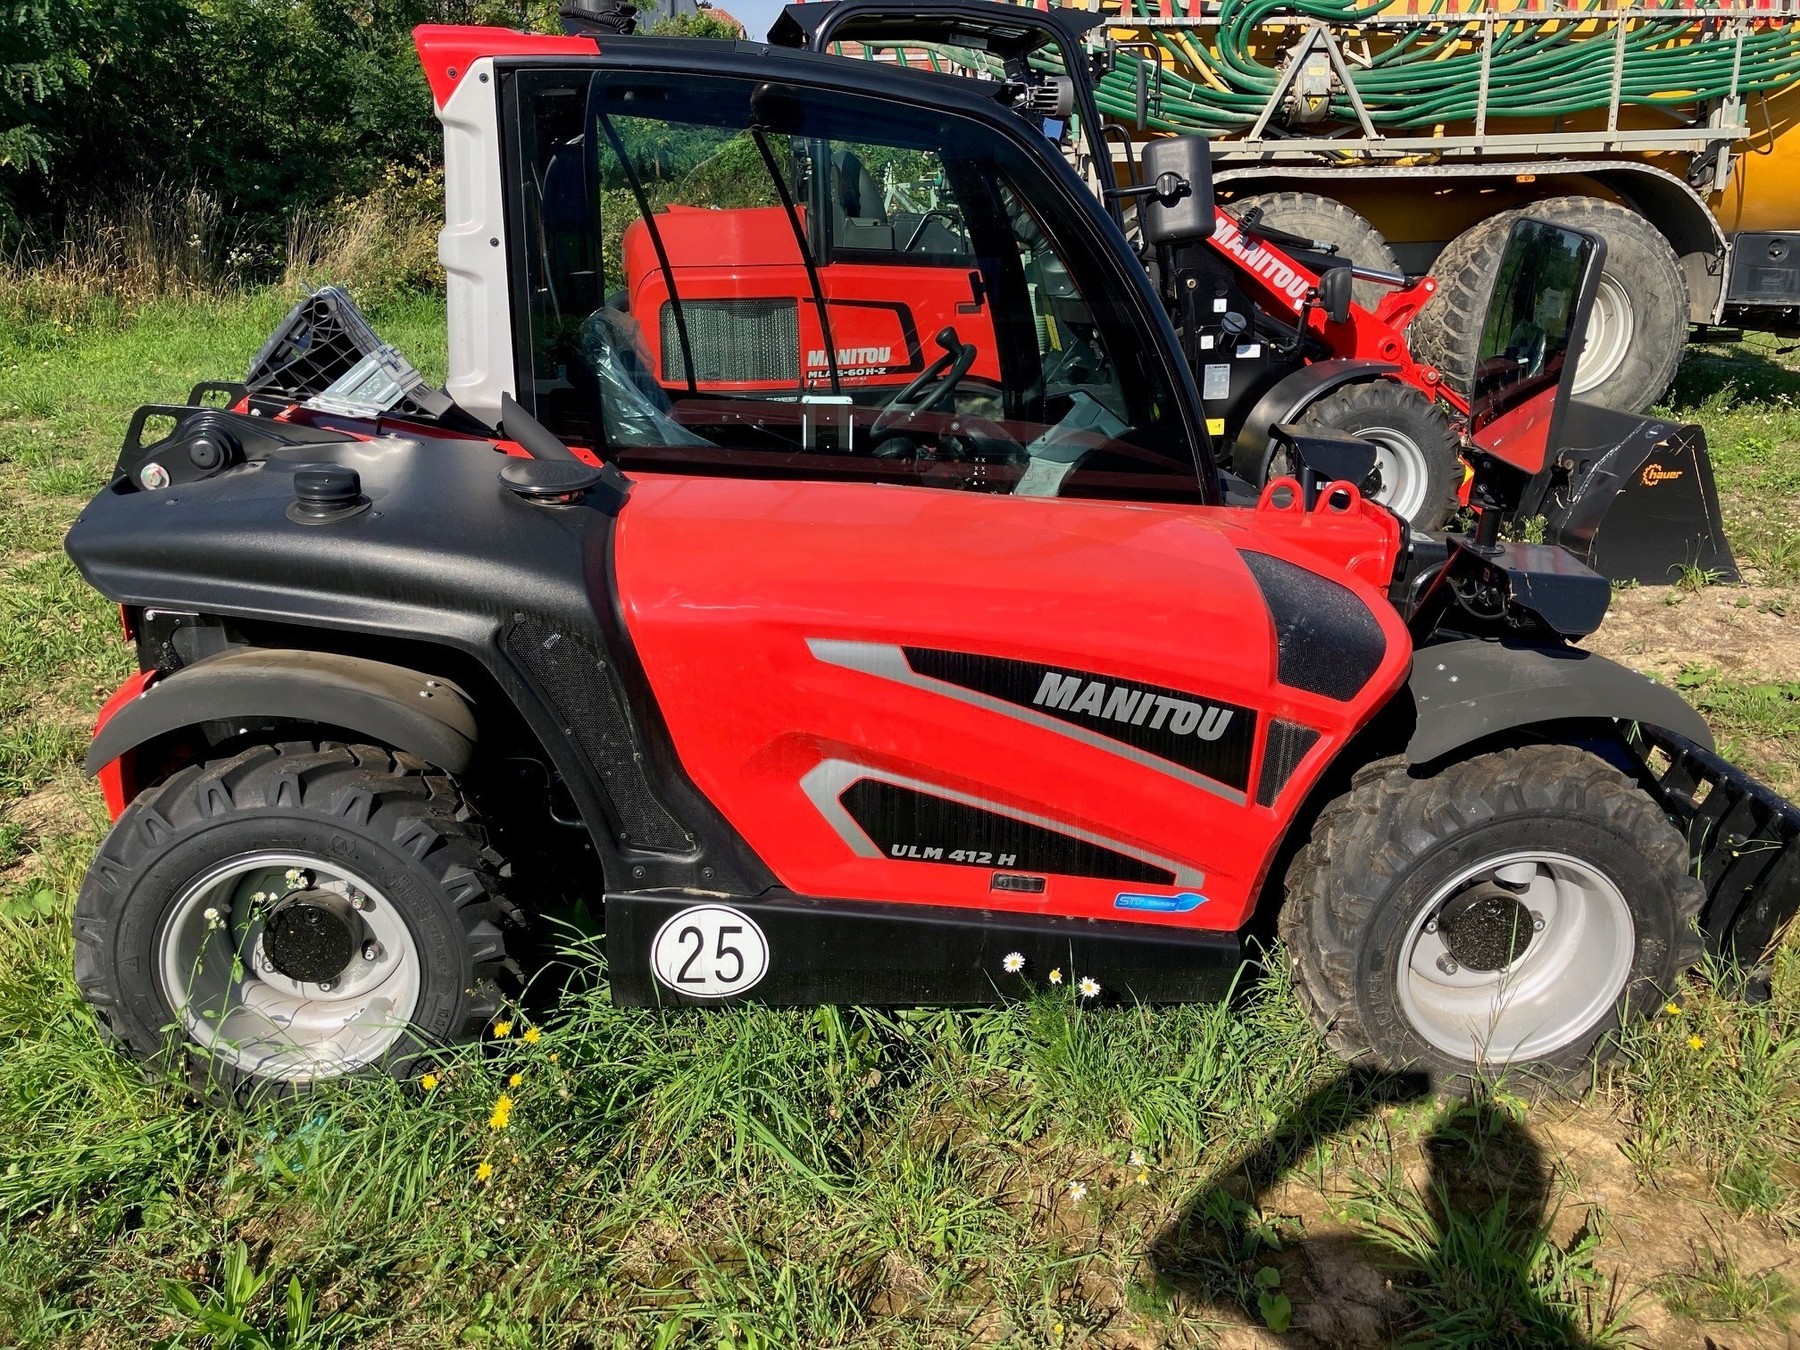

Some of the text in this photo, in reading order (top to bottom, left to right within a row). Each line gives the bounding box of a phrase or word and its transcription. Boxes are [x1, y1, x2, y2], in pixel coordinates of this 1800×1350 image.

[1212, 217, 1310, 298] MANITOU
[1648, 469, 1683, 479] hauer
[1032, 671, 1234, 741] MANITOU
[891, 844, 1017, 866] ULM 412 H
[677, 926, 744, 983] 25
